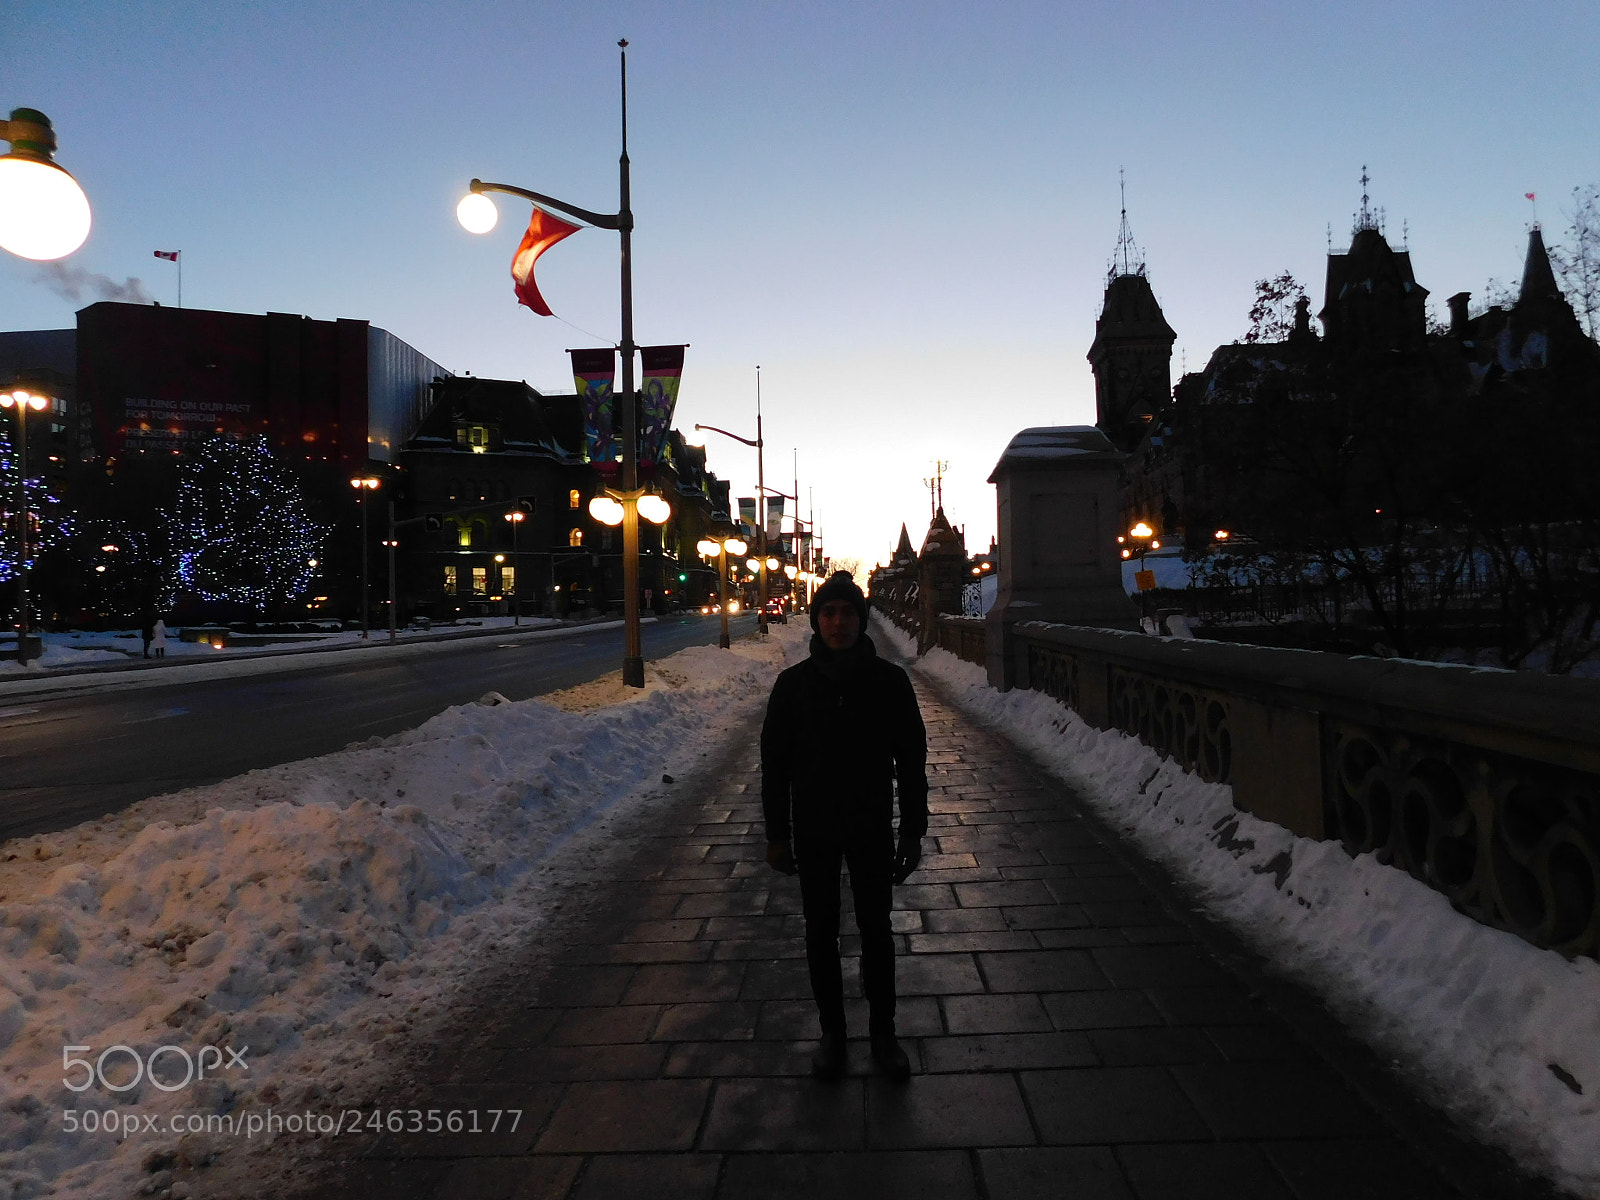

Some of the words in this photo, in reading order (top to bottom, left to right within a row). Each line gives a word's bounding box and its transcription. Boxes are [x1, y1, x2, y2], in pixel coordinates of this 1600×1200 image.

[126, 397, 177, 409] BUILDING
[180, 401, 197, 410] ON
[199, 402, 223, 412] OUR
[226, 403, 251, 413] PAST
[126, 409, 148, 419] FOR
[151, 410, 215, 423] TOMORROW
